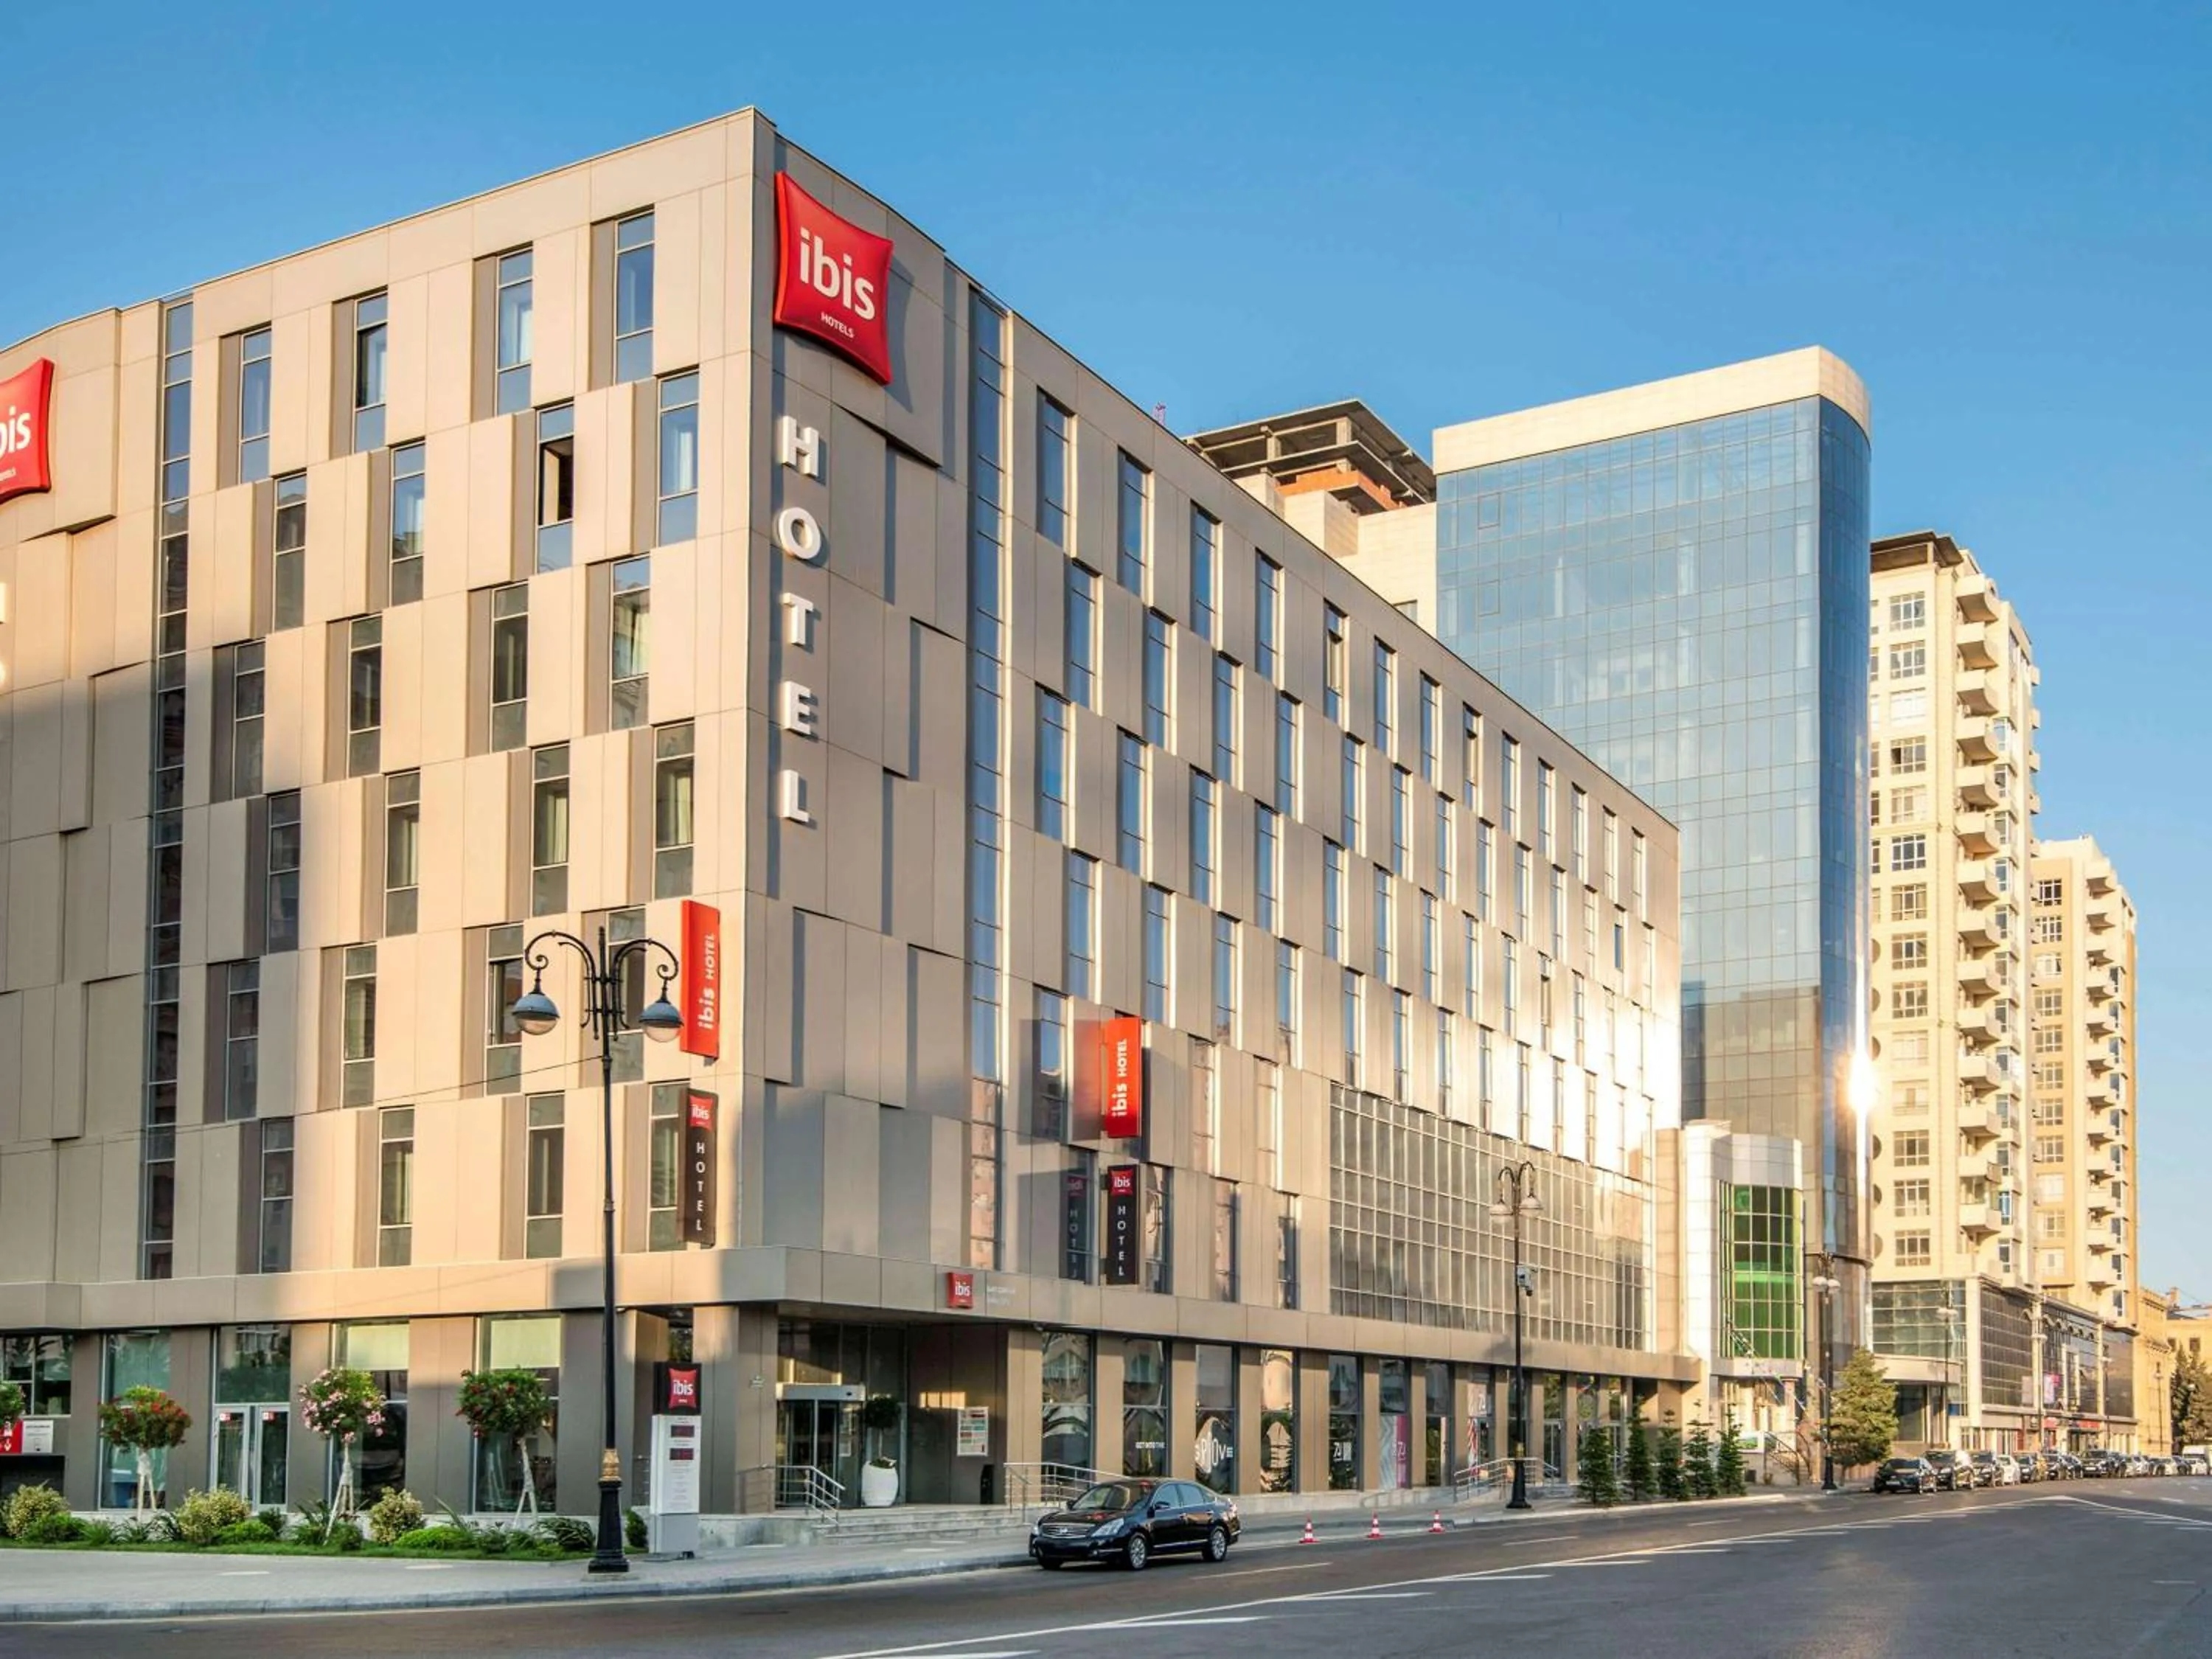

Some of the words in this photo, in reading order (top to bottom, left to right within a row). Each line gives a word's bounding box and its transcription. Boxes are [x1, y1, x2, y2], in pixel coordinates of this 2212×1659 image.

[800, 226, 875, 320] ibis
[821, 311, 855, 338] HOTELS
[778, 415, 821, 823] HOTEL
[705, 933, 714, 980] HOTEL
[698, 987, 714, 1029] ibis
[1116, 1038, 1127, 1077] HOTEL
[691, 1104, 709, 1120] ibis
[1111, 1083, 1127, 1116] ibis
[695, 1142, 706, 1231] HOTEL
[1114, 1176, 1130, 1188] ibis
[1117, 1206, 1126, 1276] HOTEL
[955, 1281, 970, 1296] ibis
[673, 1380, 693, 1396] ibis
